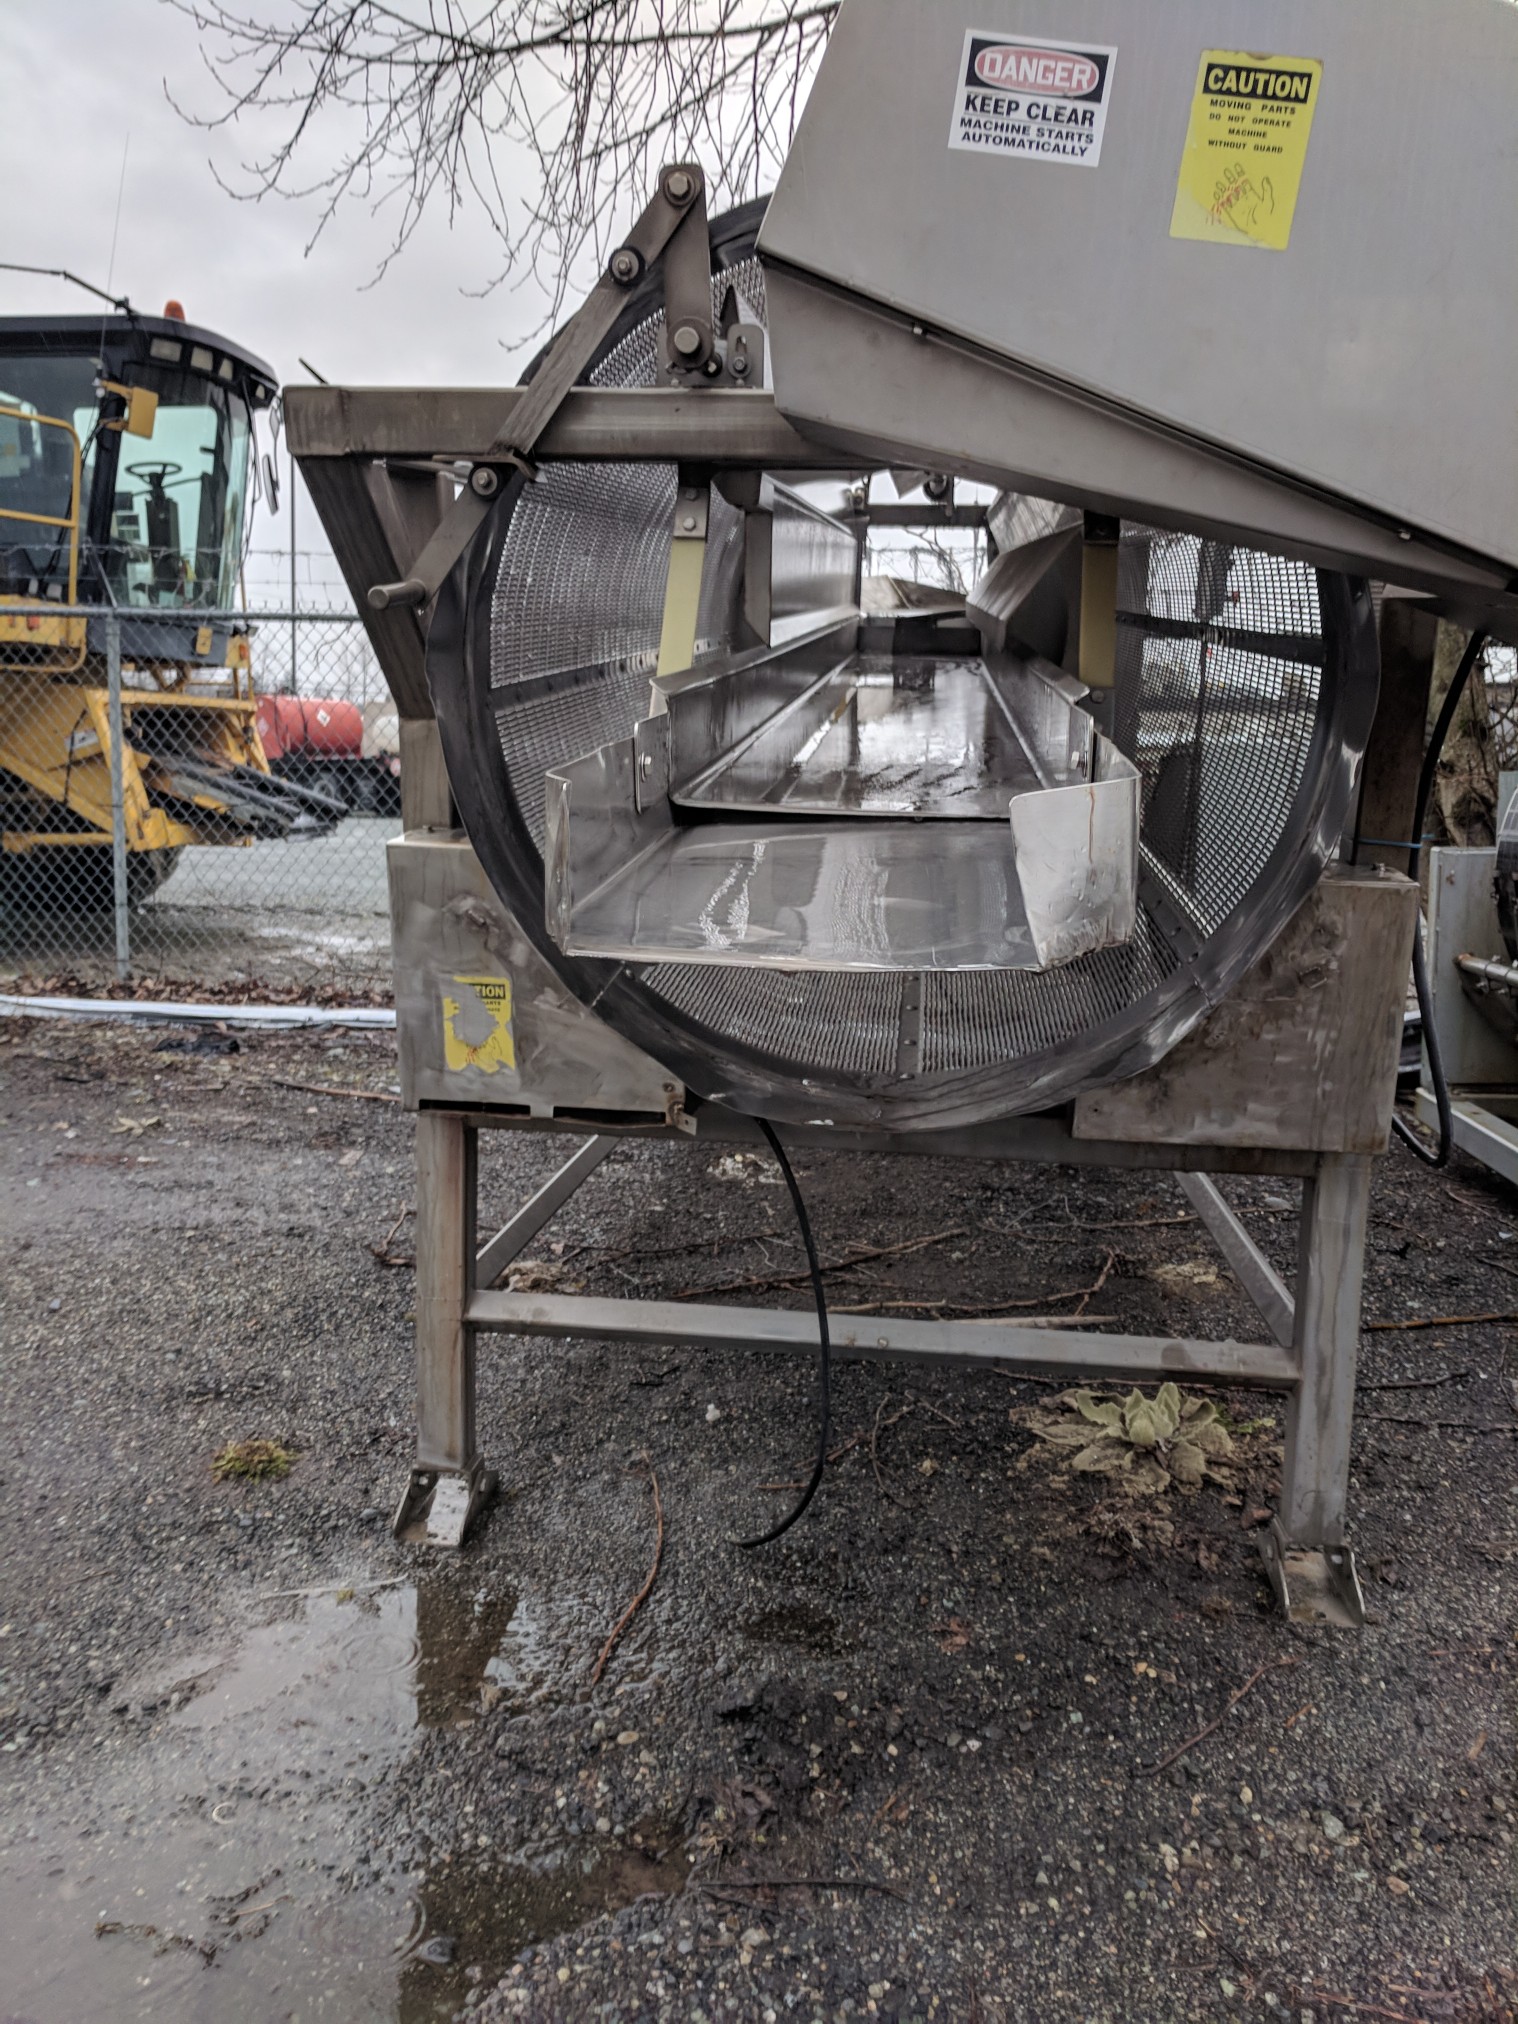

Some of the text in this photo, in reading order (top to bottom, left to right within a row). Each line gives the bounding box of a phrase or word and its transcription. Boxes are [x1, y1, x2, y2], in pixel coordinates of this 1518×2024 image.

[983, 52, 1092, 90] DANGER
[1208, 68, 1309, 99] CAUTION
[965, 94, 1095, 127] KEEP CLEAR
[1210, 99, 1296, 115] MOVING PARTS
[960, 117, 1094, 144] MACHINE STARTS
[1209, 113, 1292, 128] DO NOT OPERATE
[1228, 129, 1268, 138] MACHINE
[961, 131, 1088, 157] AUTOMATICALLY
[1208, 139, 1283, 154] WITHOUT GUARD
